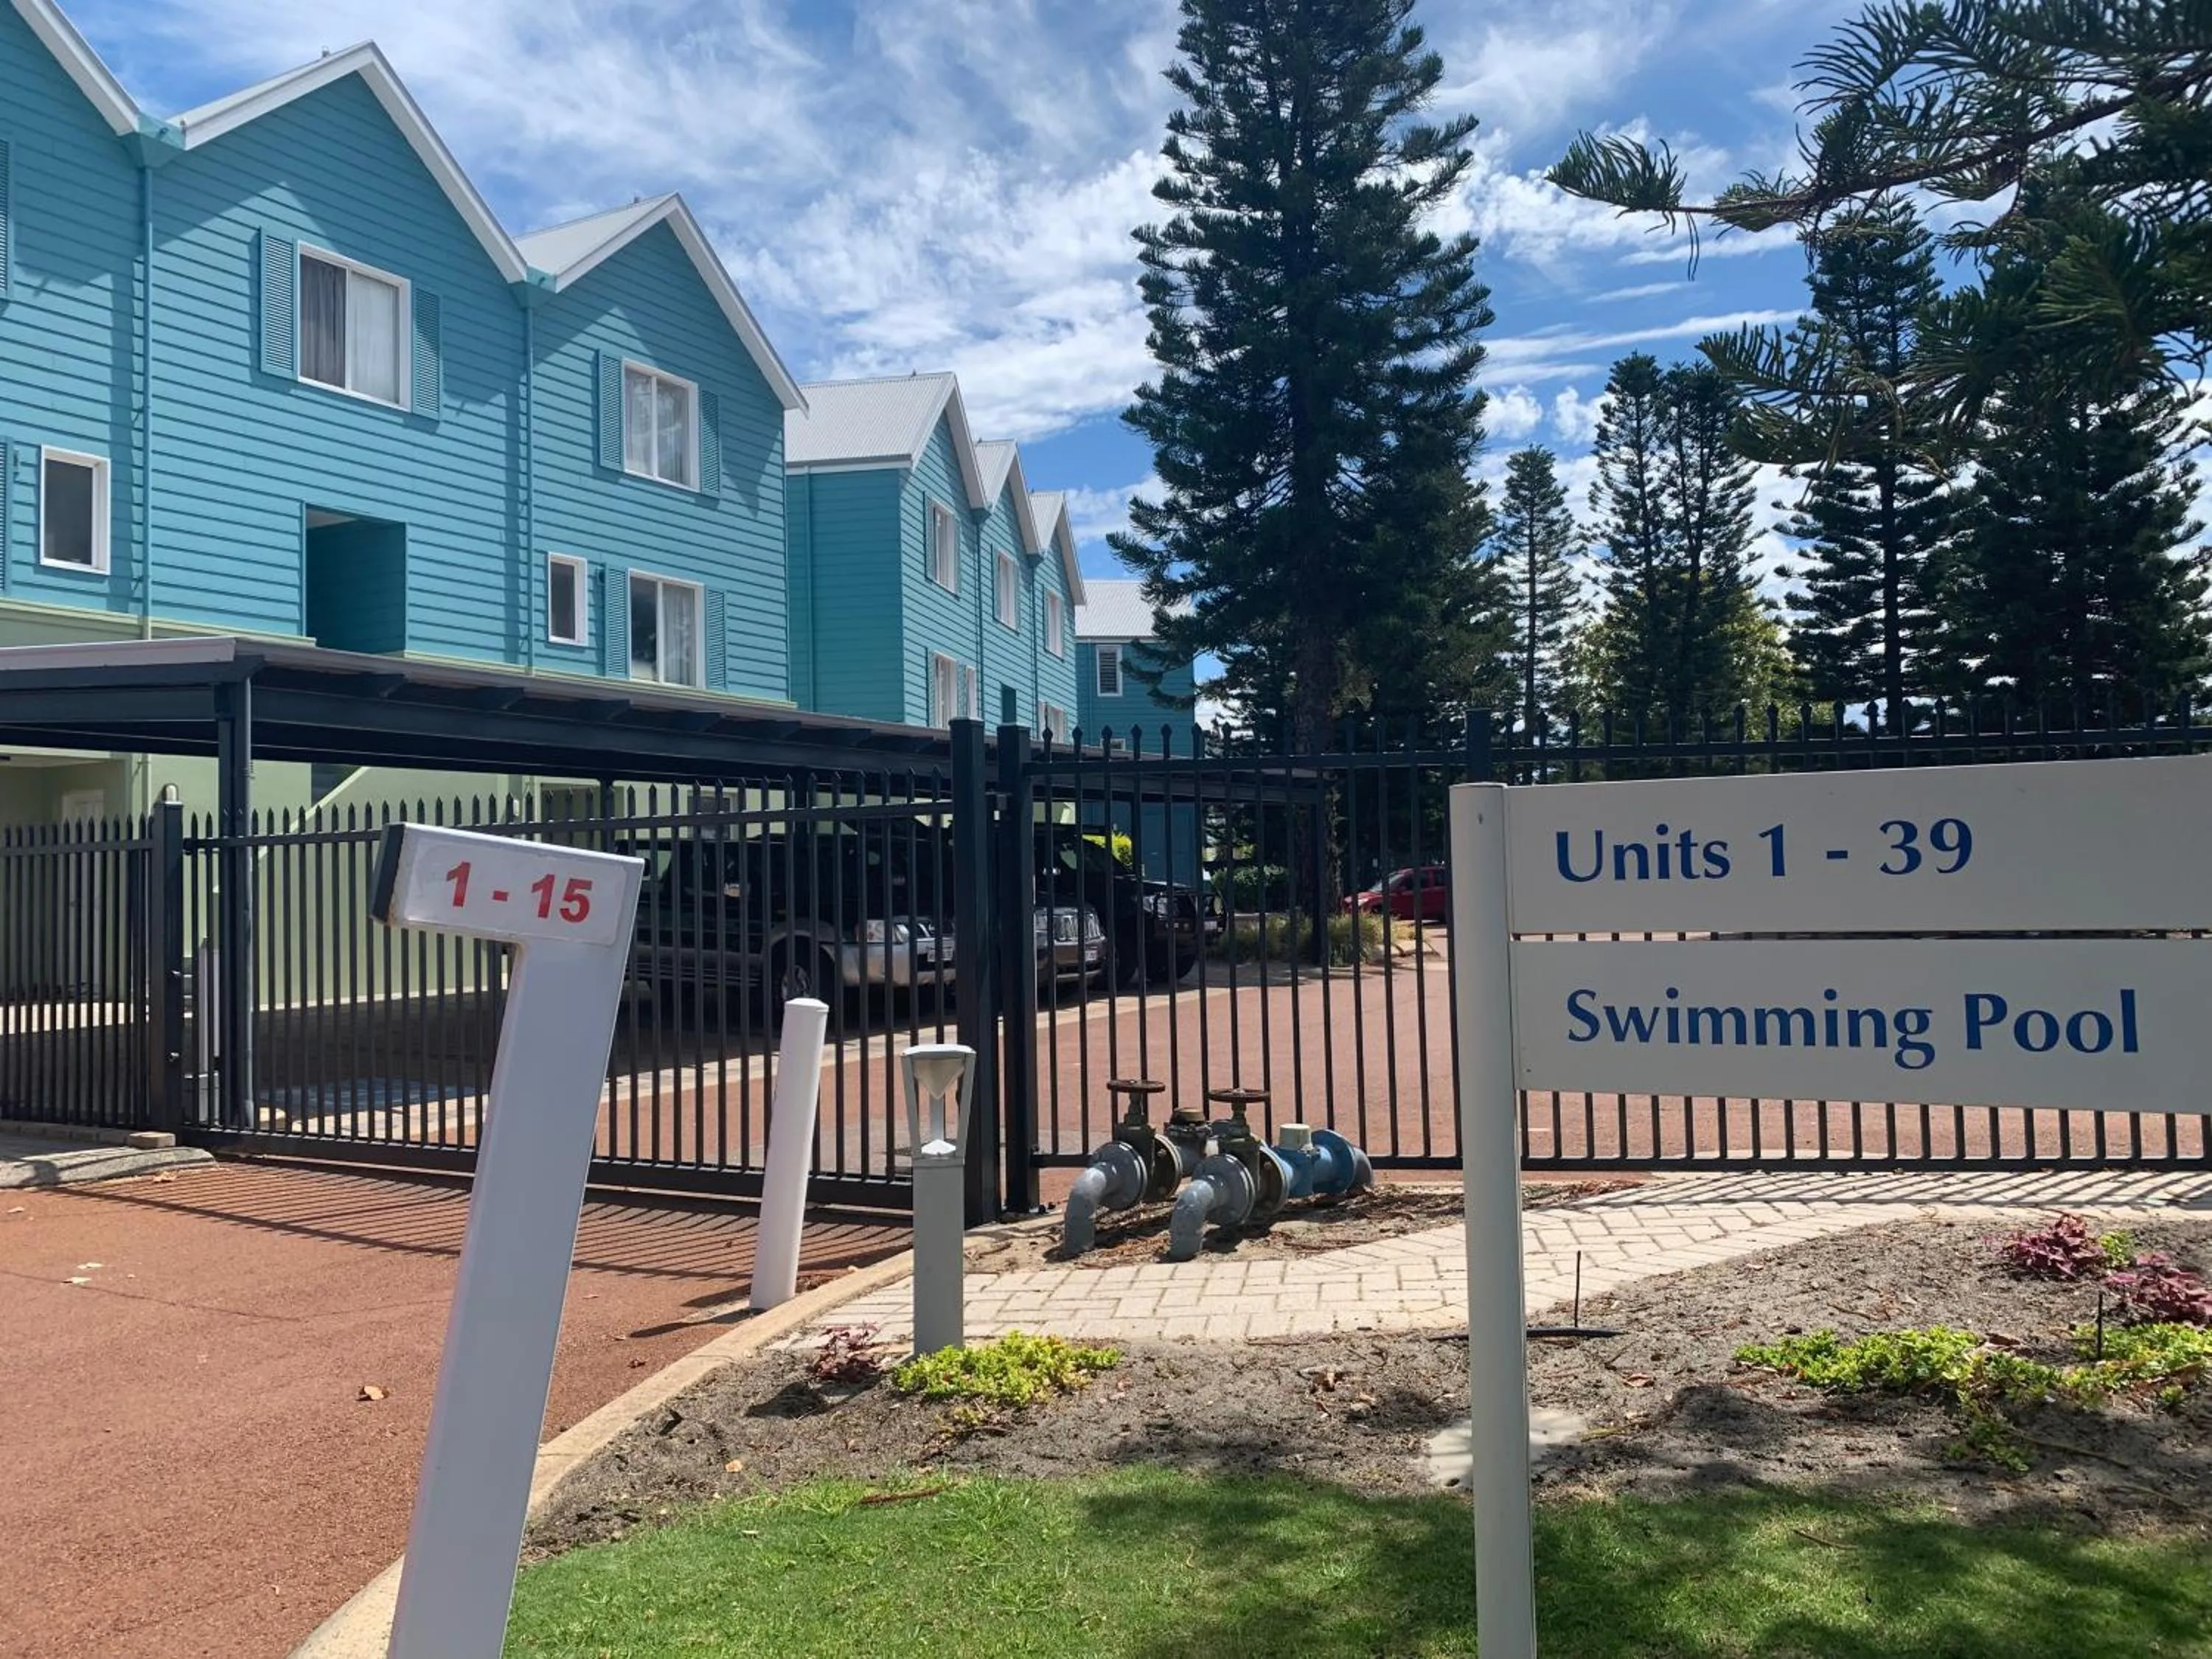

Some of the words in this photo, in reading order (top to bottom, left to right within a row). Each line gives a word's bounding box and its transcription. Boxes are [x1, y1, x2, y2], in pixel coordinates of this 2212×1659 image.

[1555, 824, 1731, 883] Units
[1759, 824, 1787, 877] 1
[1826, 849, 1849, 860] -
[1879, 818, 1974, 875] 39
[445, 861, 471, 908] 1
[491, 890, 509, 902] -
[529, 873, 594, 923] 15
[1566, 988, 1936, 1070] Swimming
[1964, 988, 2139, 1054] Pool
